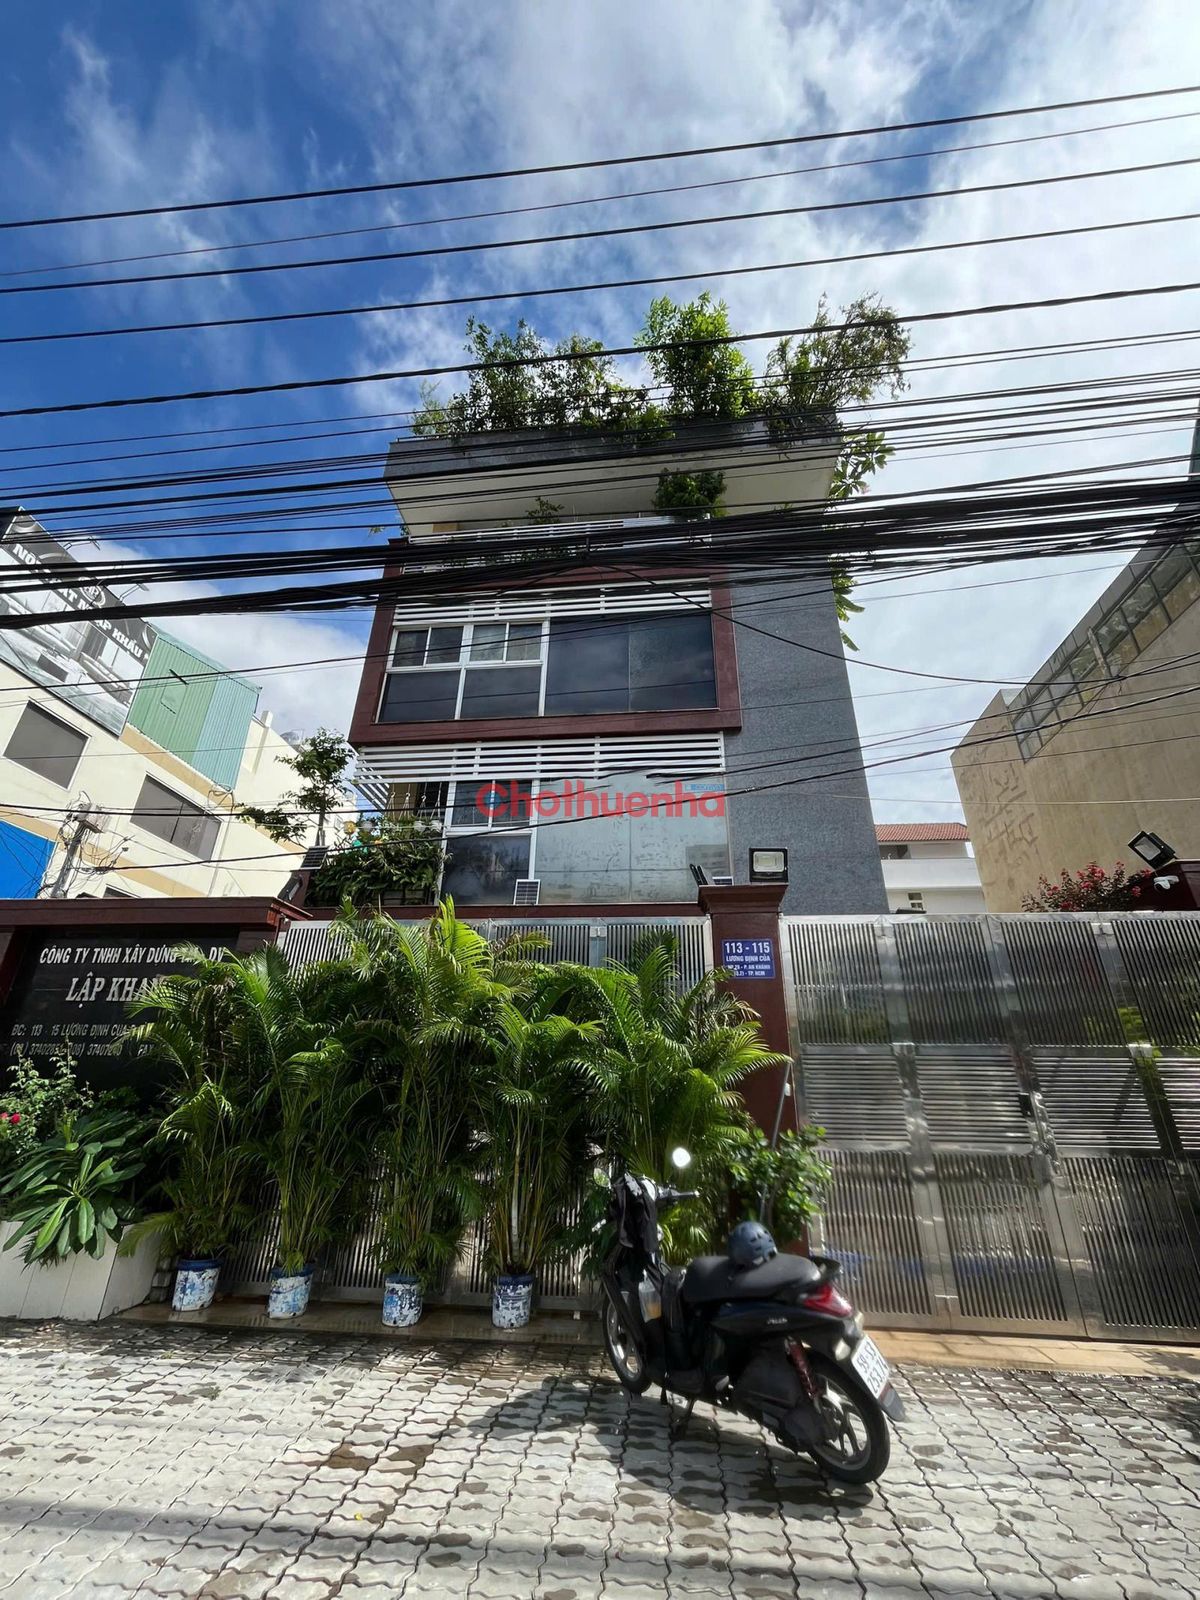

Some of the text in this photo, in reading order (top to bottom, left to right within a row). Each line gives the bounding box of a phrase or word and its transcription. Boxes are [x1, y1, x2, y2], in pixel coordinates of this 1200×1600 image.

[40, 945, 72, 964] CÔNG
[74, 947, 91, 964] TY
[92, 947, 122, 964] TNHH
[122, 943, 147, 964] XÂY
[725, 942, 743, 954] 113
[752, 942, 770, 954] 115
[65, 971, 106, 1009] LẬP
